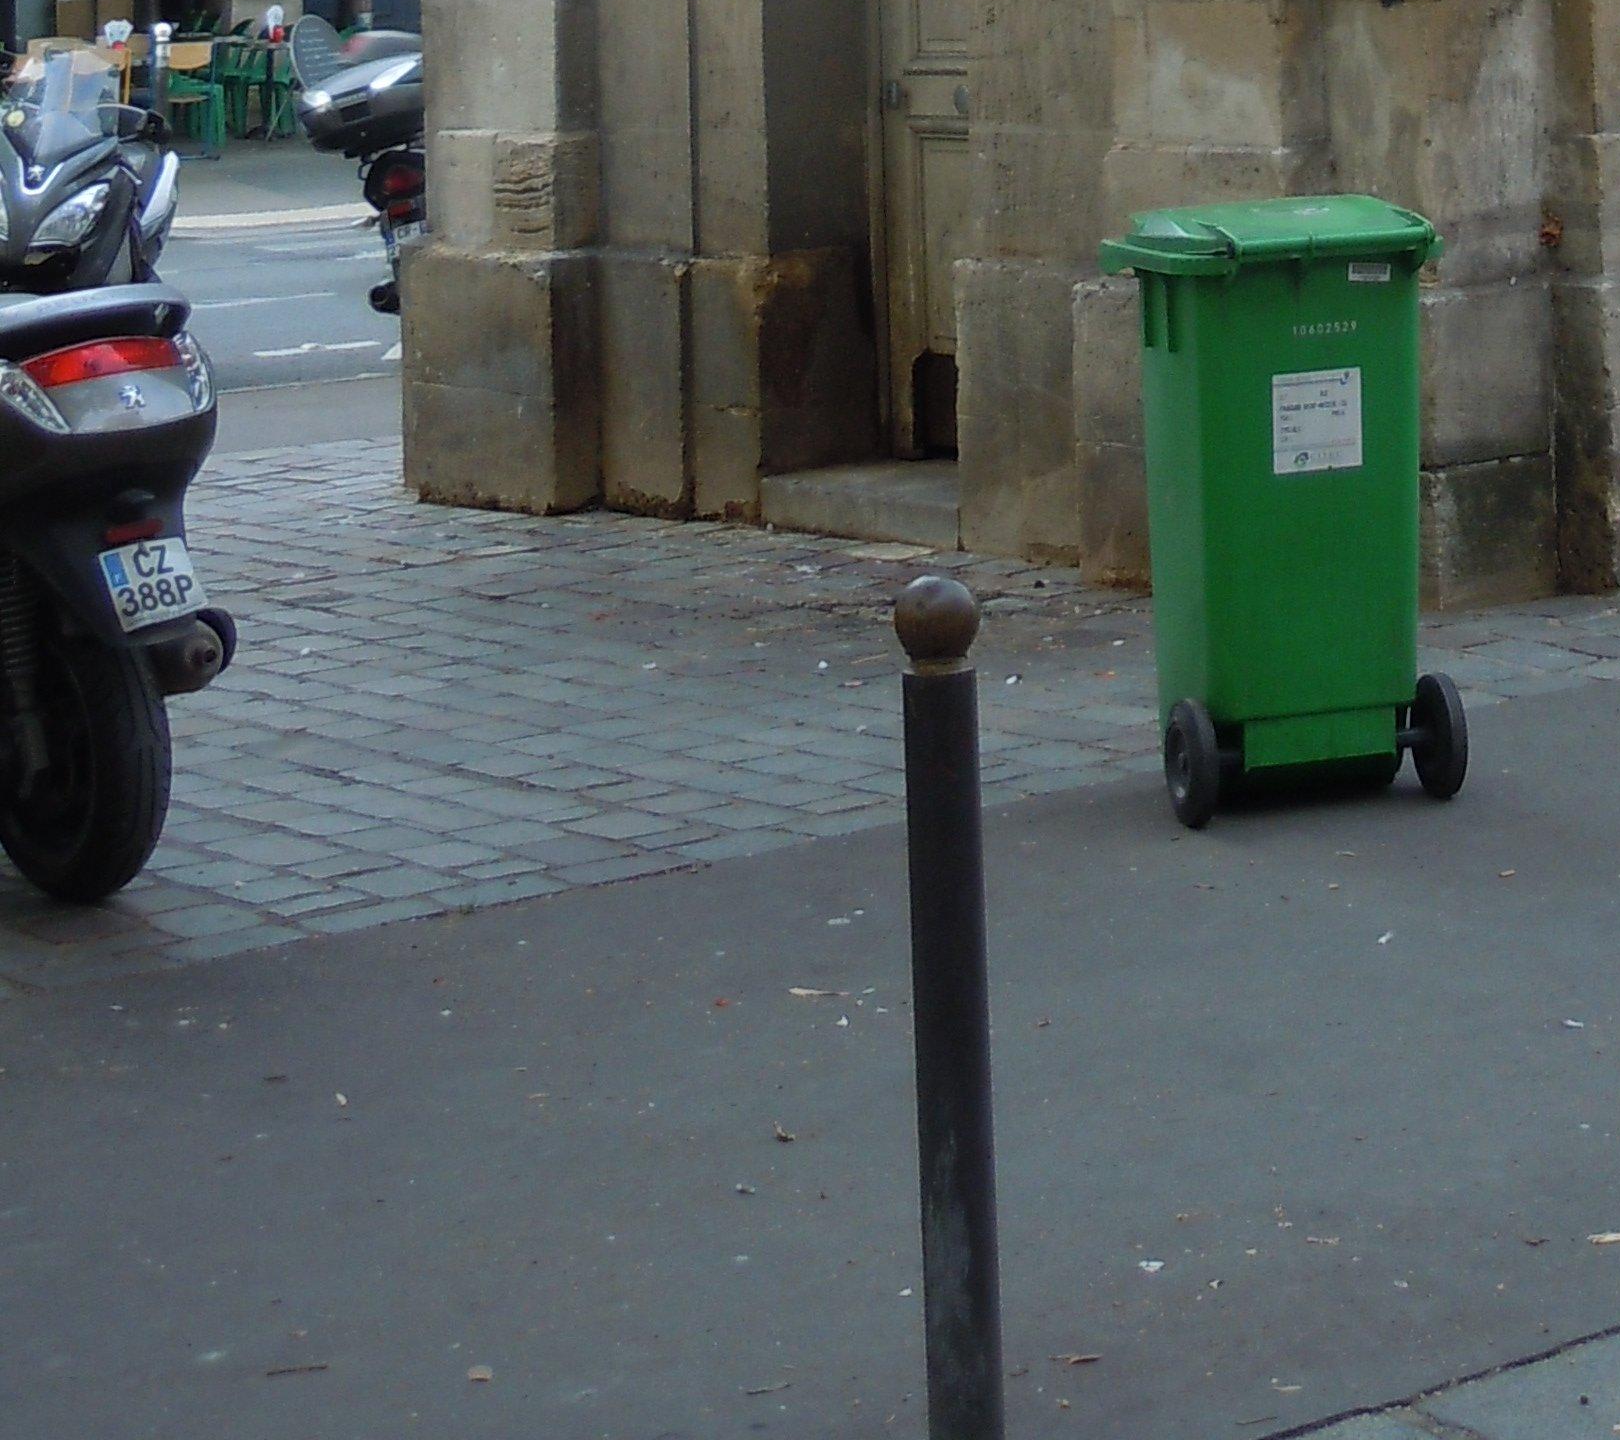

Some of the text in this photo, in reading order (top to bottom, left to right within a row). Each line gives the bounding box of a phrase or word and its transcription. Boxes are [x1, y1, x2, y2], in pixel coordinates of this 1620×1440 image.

[1293, 320, 1357, 336] 10602529
[133, 544, 174, 577] CZ
[118, 574, 193, 617] 388P
